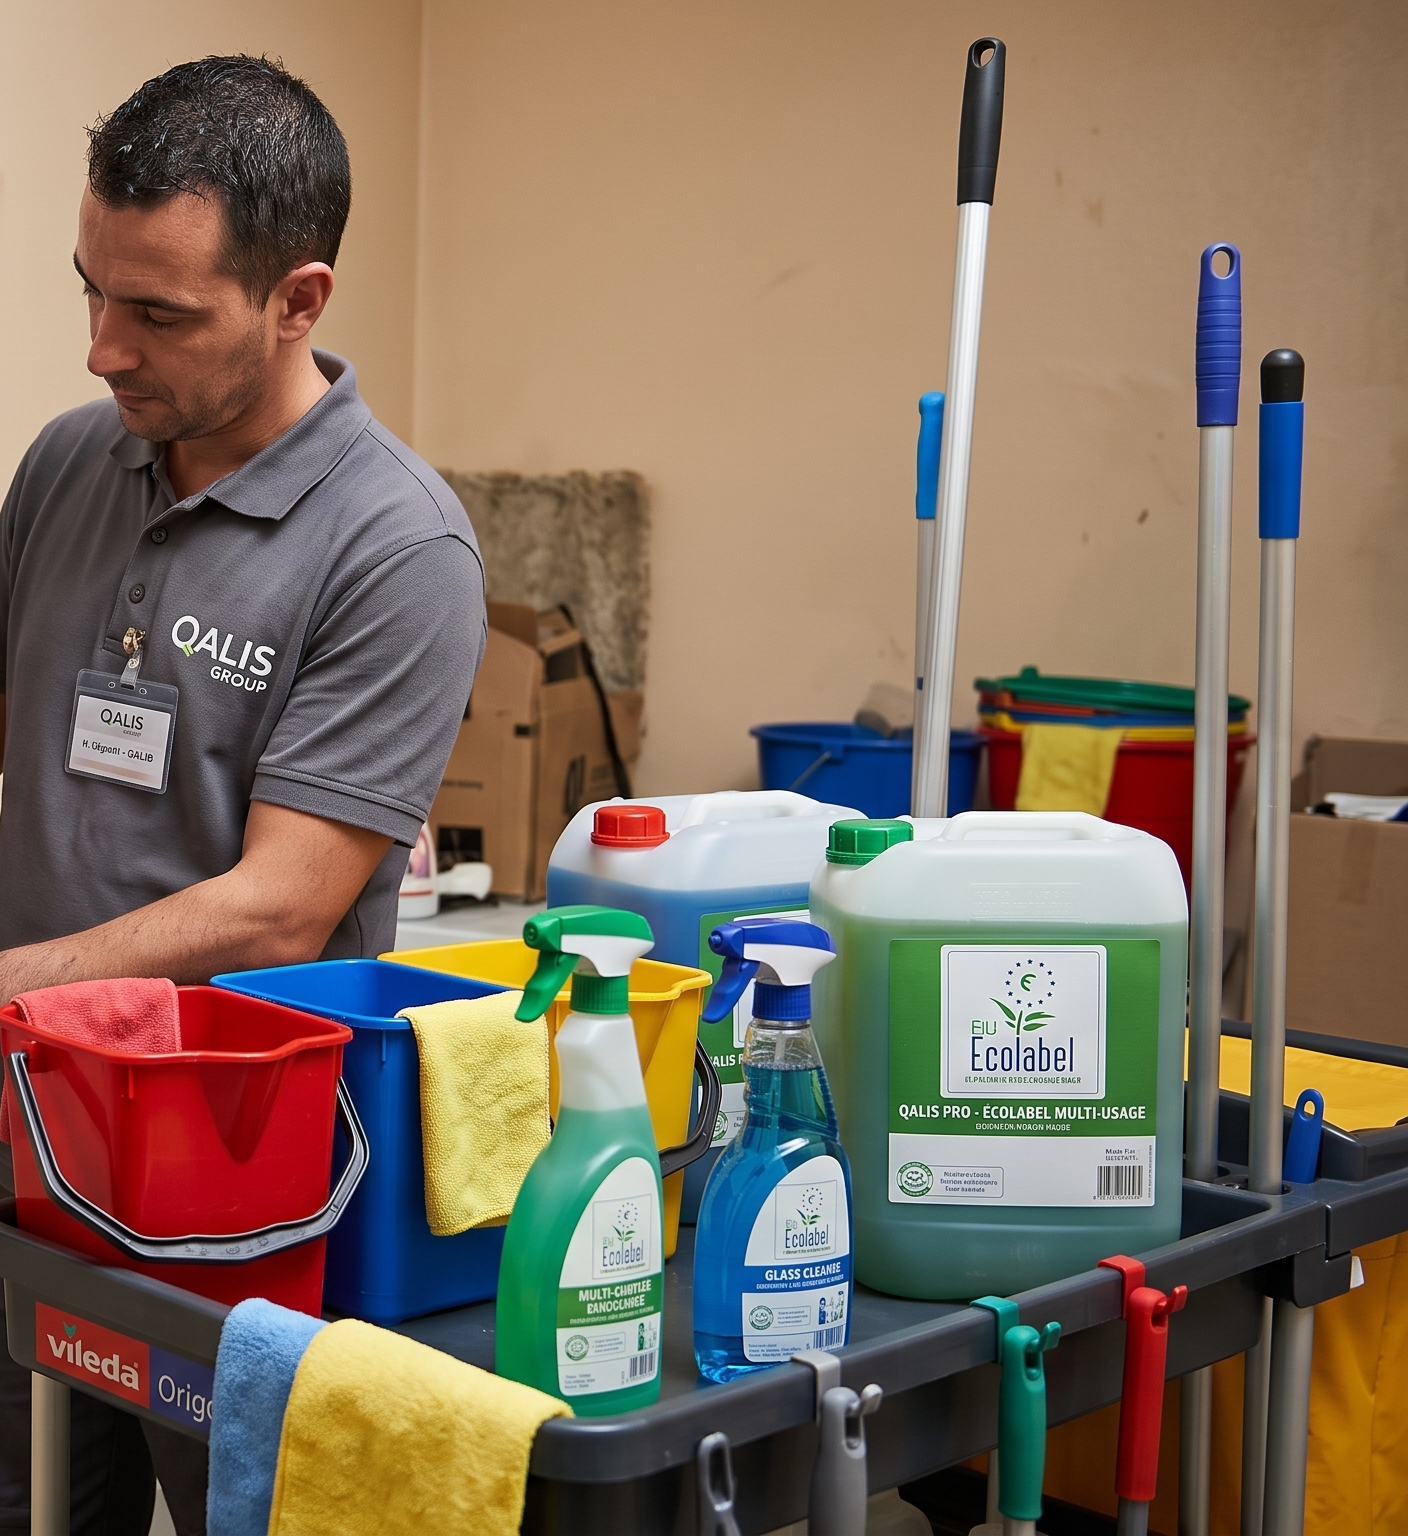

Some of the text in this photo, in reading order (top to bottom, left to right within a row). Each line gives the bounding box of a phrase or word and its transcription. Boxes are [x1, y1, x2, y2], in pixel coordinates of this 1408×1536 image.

[171, 615, 276, 677] QALIS
[210, 666, 268, 693] GROUP
[100, 708, 144, 730] QALIS
[711, 1054, 736, 1067] ALIS
[971, 1036, 1074, 1072] Ecolabel
[898, 1104, 939, 1120] QALIS
[943, 1105, 970, 1118] PRO
[983, 1103, 1051, 1119] ÉCOLABEL
[1054, 1106, 1146, 1120] MULTI-USAGE
[786, 1224, 828, 1248] Ecolabel
[765, 1268, 801, 1281] GLASS
[47, 1334, 140, 1391] vileda
